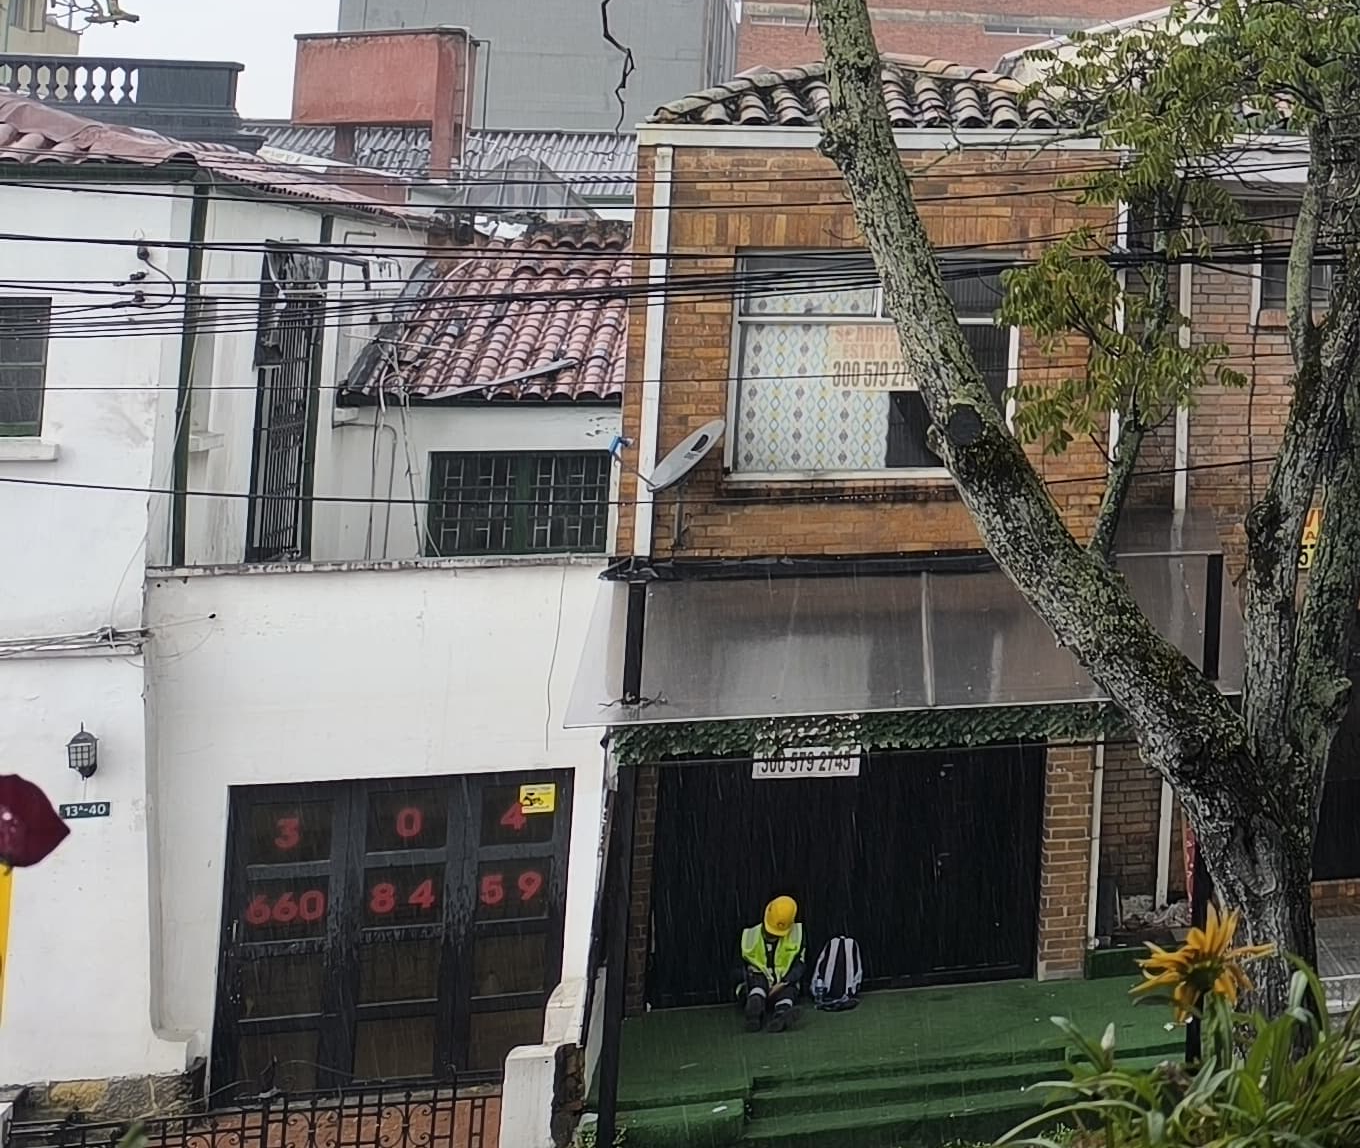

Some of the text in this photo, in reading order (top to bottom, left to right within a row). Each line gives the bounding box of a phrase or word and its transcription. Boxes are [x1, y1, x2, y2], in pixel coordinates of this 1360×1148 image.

[856, 327, 897, 342] ARRIE
[843, 343, 900, 359] ESTA CA
[832, 361, 915, 387] 300 579 274
[790, 751, 816, 772] 579
[273, 817, 301, 849] 3
[499, 803, 527, 831] 4
[245, 889, 326, 925] 660
